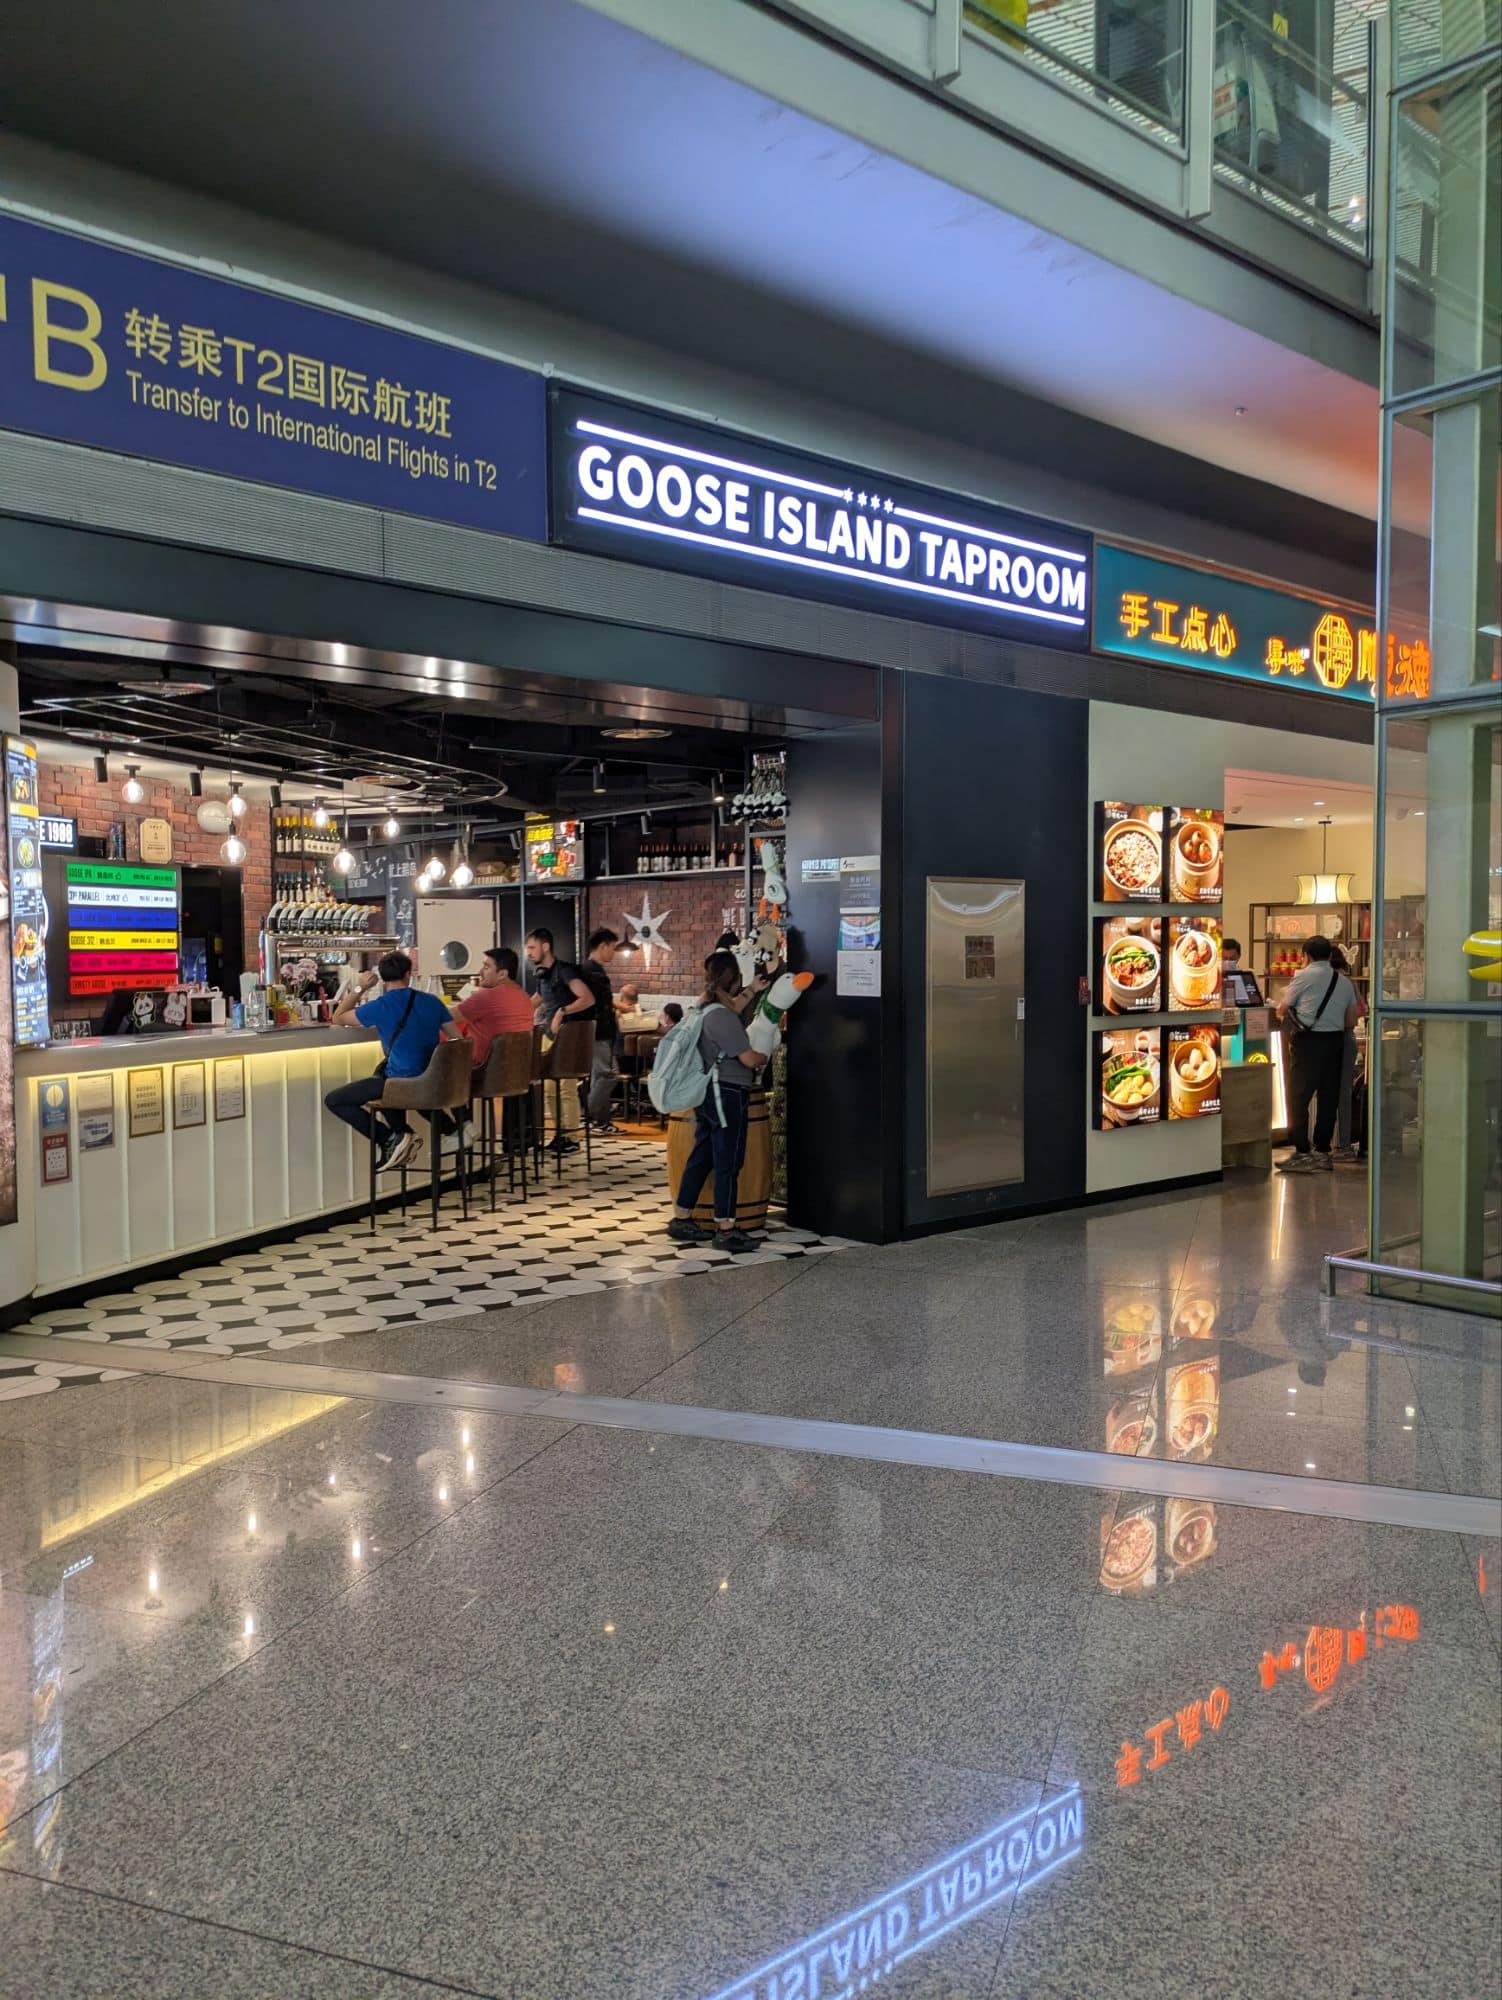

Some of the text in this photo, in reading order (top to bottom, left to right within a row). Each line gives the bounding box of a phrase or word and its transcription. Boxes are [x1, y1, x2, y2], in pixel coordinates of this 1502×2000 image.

[32, 277, 108, 391] B
[124, 307, 453, 440] 转乘T2国际航班
[126, 370, 498, 491] Transfer to International Flights in T2
[577, 444, 1087, 611] GOOSE ISLAND TAPROOM
[1119, 591, 1237, 657] 手工点心
[48, 821, 74, 844] 1988
